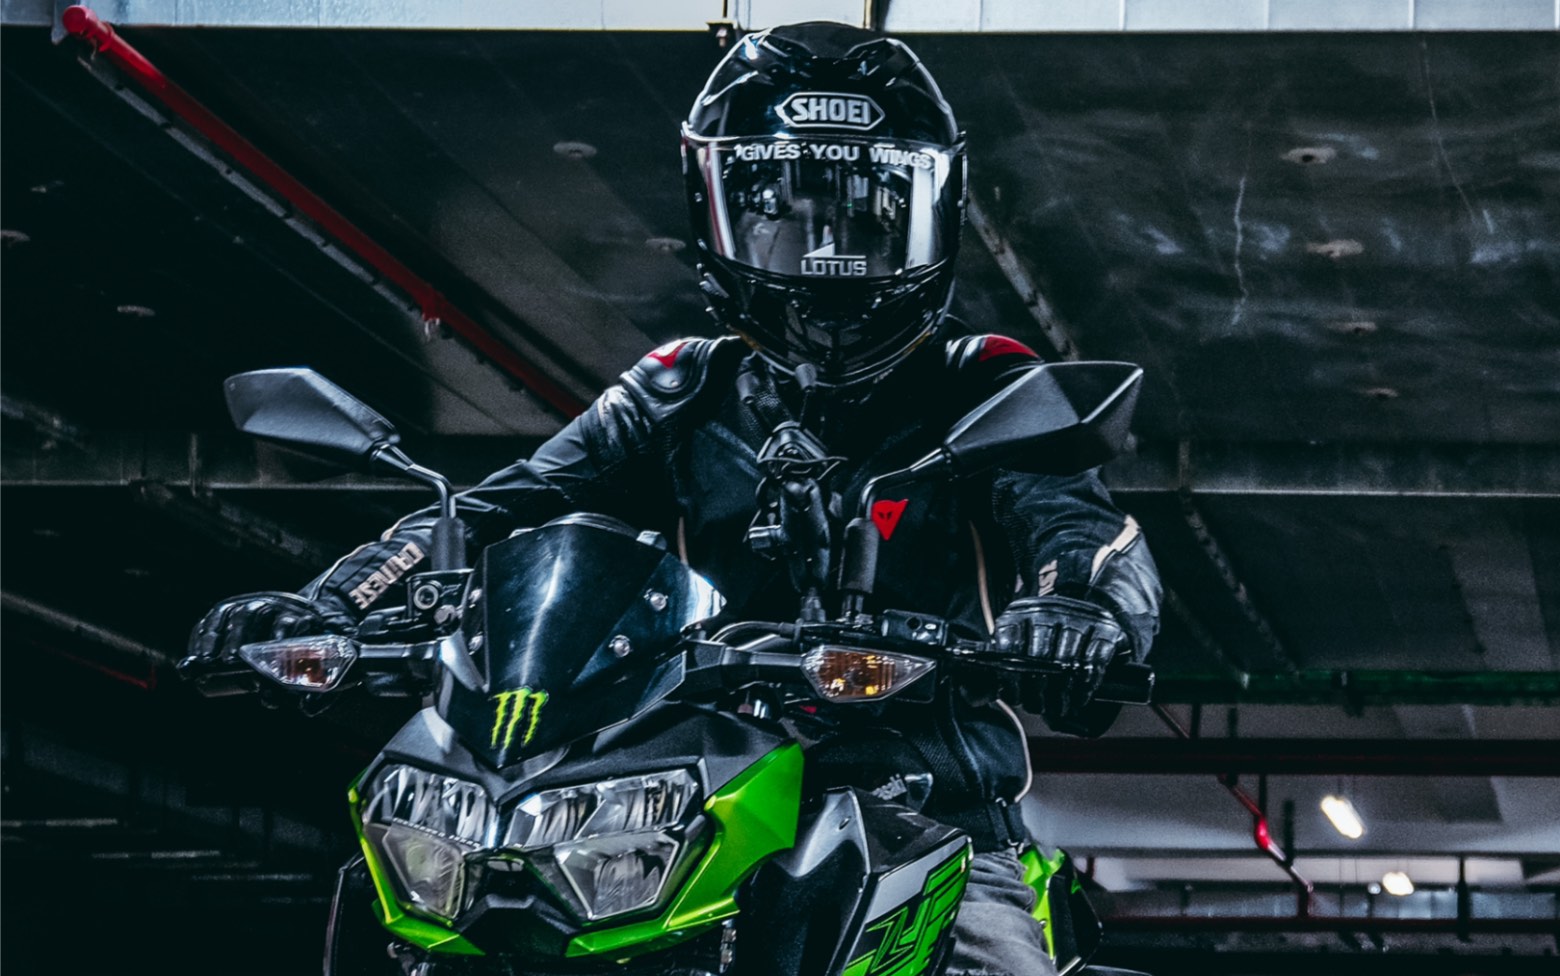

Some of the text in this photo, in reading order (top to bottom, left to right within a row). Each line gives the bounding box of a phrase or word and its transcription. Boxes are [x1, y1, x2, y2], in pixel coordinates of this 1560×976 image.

[790, 97, 871, 125] SHOEI
[740, 142, 933, 170] GIVES YOU WINGS
[800, 259, 867, 276] LOTUS
[347, 541, 425, 611] DAINESE
